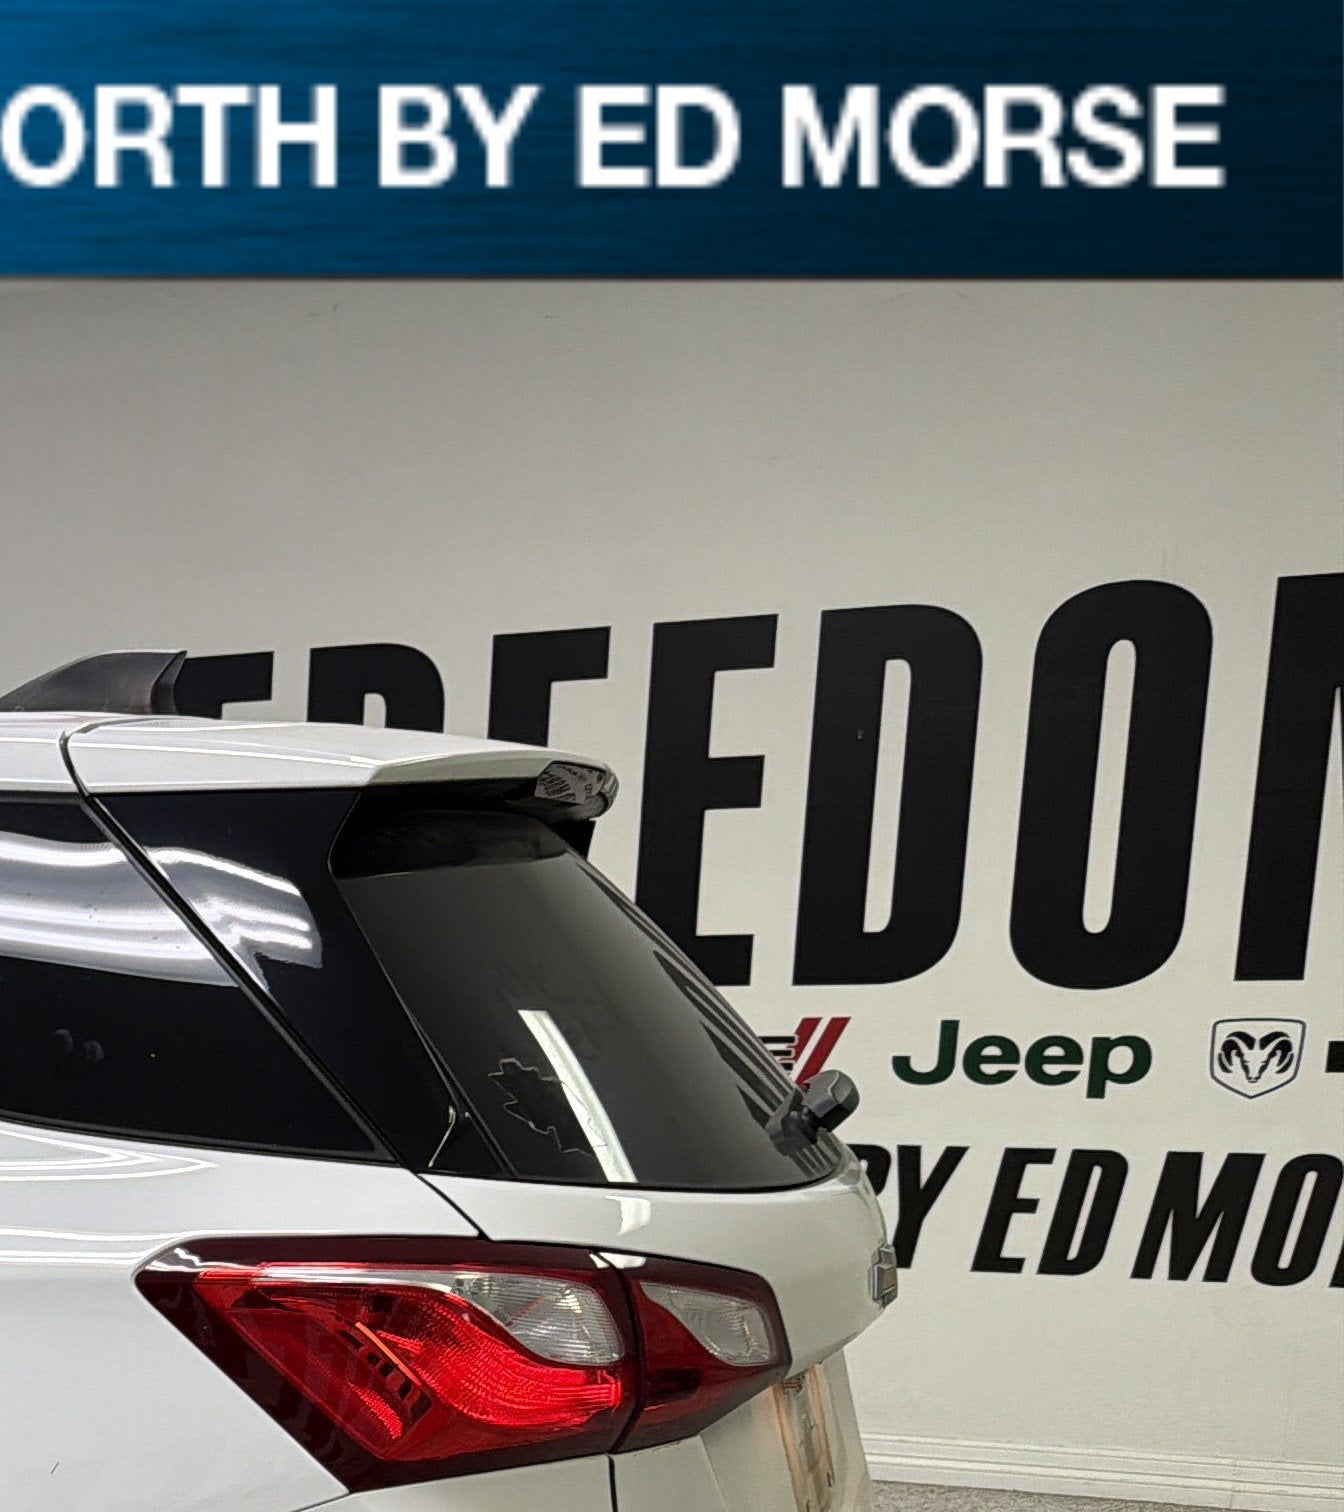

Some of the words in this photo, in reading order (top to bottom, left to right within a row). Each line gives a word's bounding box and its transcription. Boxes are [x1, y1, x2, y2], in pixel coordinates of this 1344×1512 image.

[892, 1019, 1153, 1100] Jeep
[970, 1147, 1130, 1276] ED
[1130, 1151, 1344, 1289] MO
